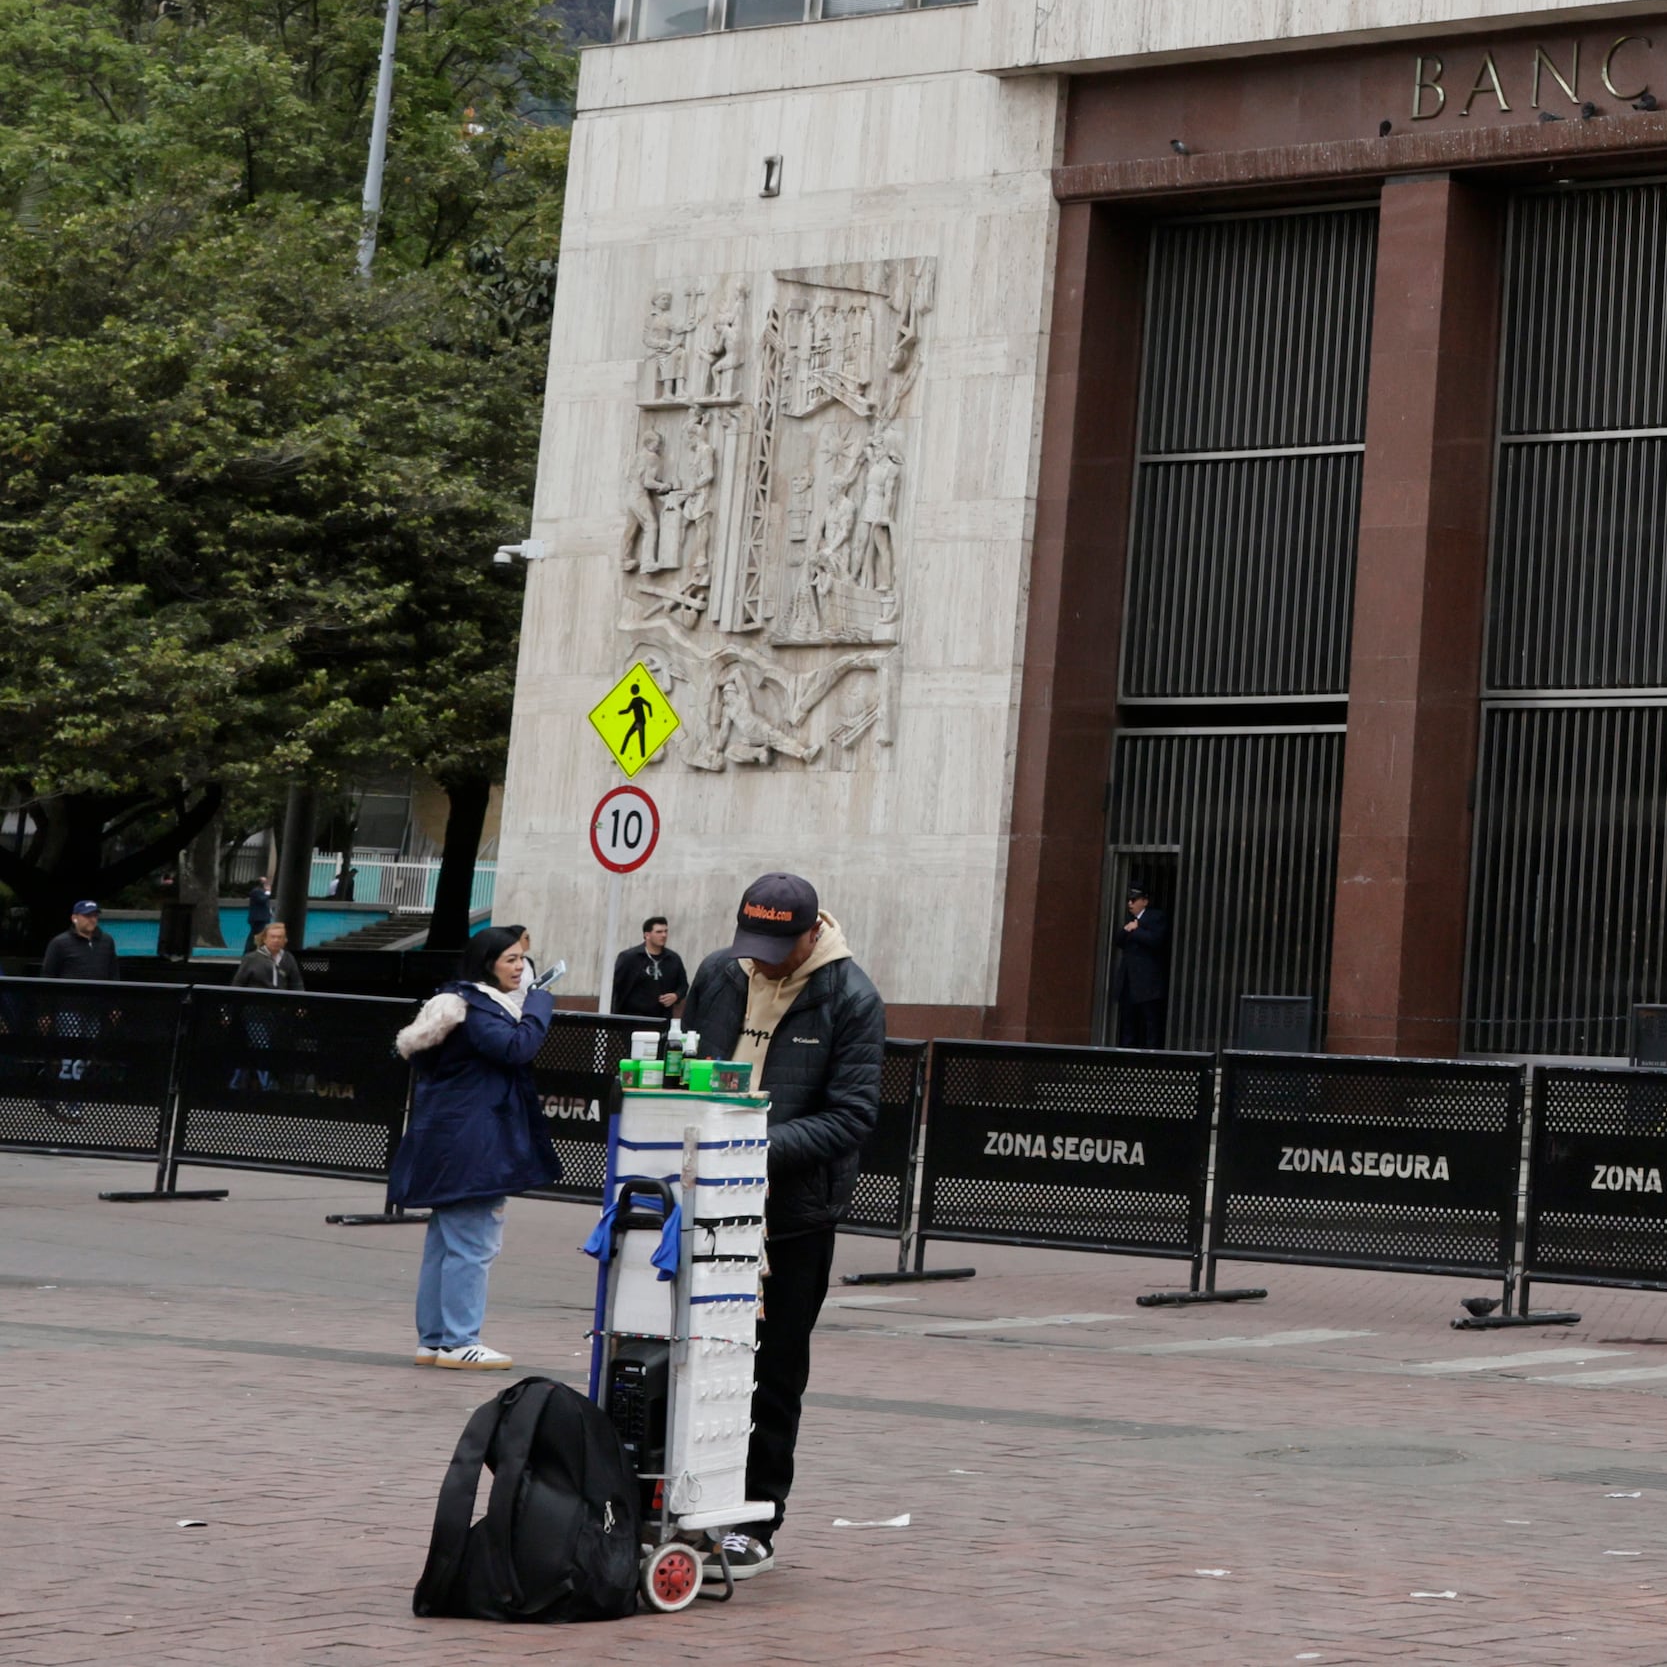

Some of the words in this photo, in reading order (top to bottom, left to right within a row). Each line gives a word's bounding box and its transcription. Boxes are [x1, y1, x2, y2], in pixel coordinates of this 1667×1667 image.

[611, 808, 643, 850] 10
[984, 1132, 1047, 1159] ZONA
[1051, 1136, 1145, 1166] SEGURA
[1278, 1147, 1346, 1174] ZONA
[1350, 1151, 1450, 1181] SEGURA
[1591, 1165, 1663, 1193] ZONA
